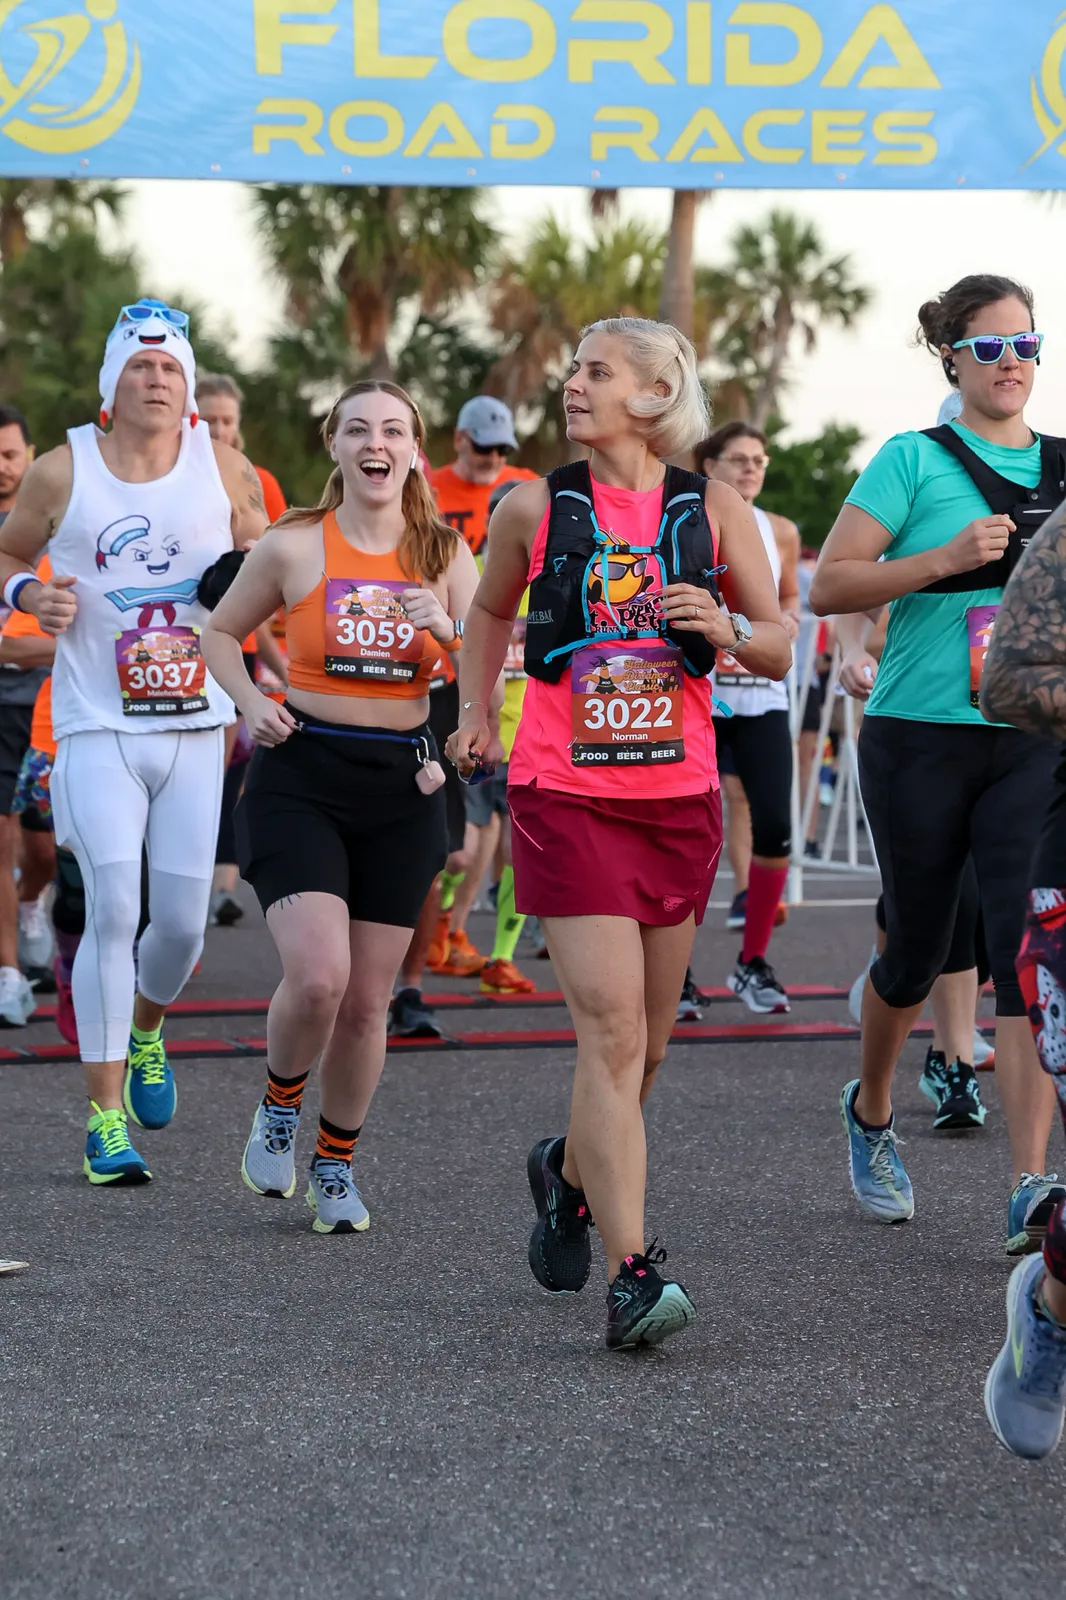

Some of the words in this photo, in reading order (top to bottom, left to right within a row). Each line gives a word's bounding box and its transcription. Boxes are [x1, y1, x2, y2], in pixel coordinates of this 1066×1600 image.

[253, 0, 942, 88] FLORIDA
[253, 98, 556, 159] ROAD
[590, 106, 938, 165] RACES
[616, 607, 660, 629] Pet
[336, 618, 414, 649] 3059
[360, 648, 390, 657] Damien
[332, 664, 356, 672] FOOD
[362, 665, 386, 674] BEER
[393, 668, 413, 677] BEER
[624, 660, 678, 669] Halloween
[128, 661, 198, 689] 3037
[182, 701, 202, 710] BEER
[584, 696, 672, 729] 3022
[611, 732, 648, 741] Norman
[581, 752, 609, 760] FOOD
[616, 752, 644, 760] BEER
[651, 749, 676, 758] BEER
